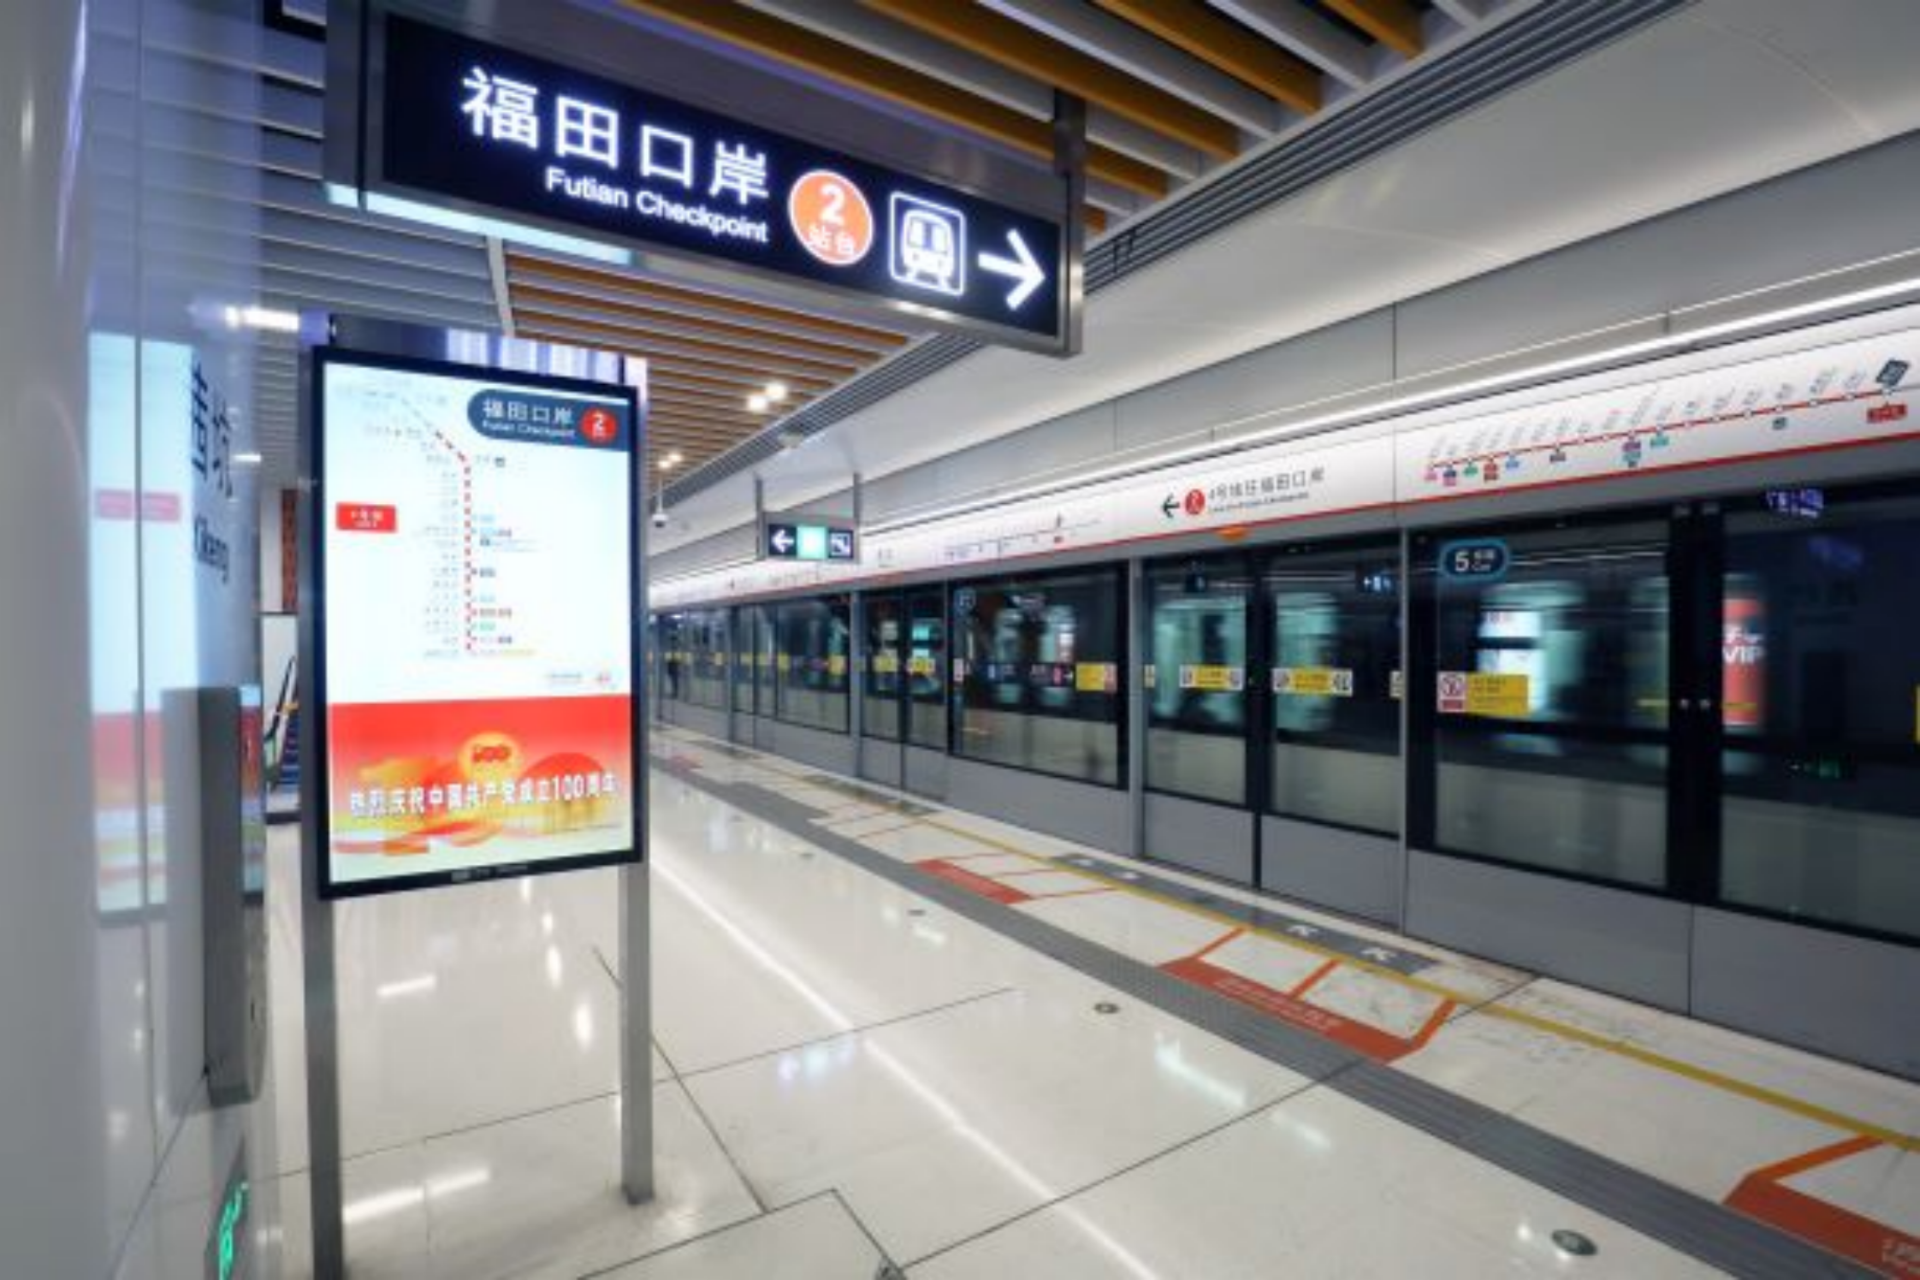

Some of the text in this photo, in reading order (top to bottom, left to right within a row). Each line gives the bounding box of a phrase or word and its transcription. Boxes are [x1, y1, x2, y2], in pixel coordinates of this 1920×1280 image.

[461, 66, 770, 205] 福田口岸
[545, 166, 769, 243] Futian Checkpoint
[819, 184, 846, 226] 2
[482, 398, 574, 428] 福田口岸
[1455, 551, 1469, 572] 5
